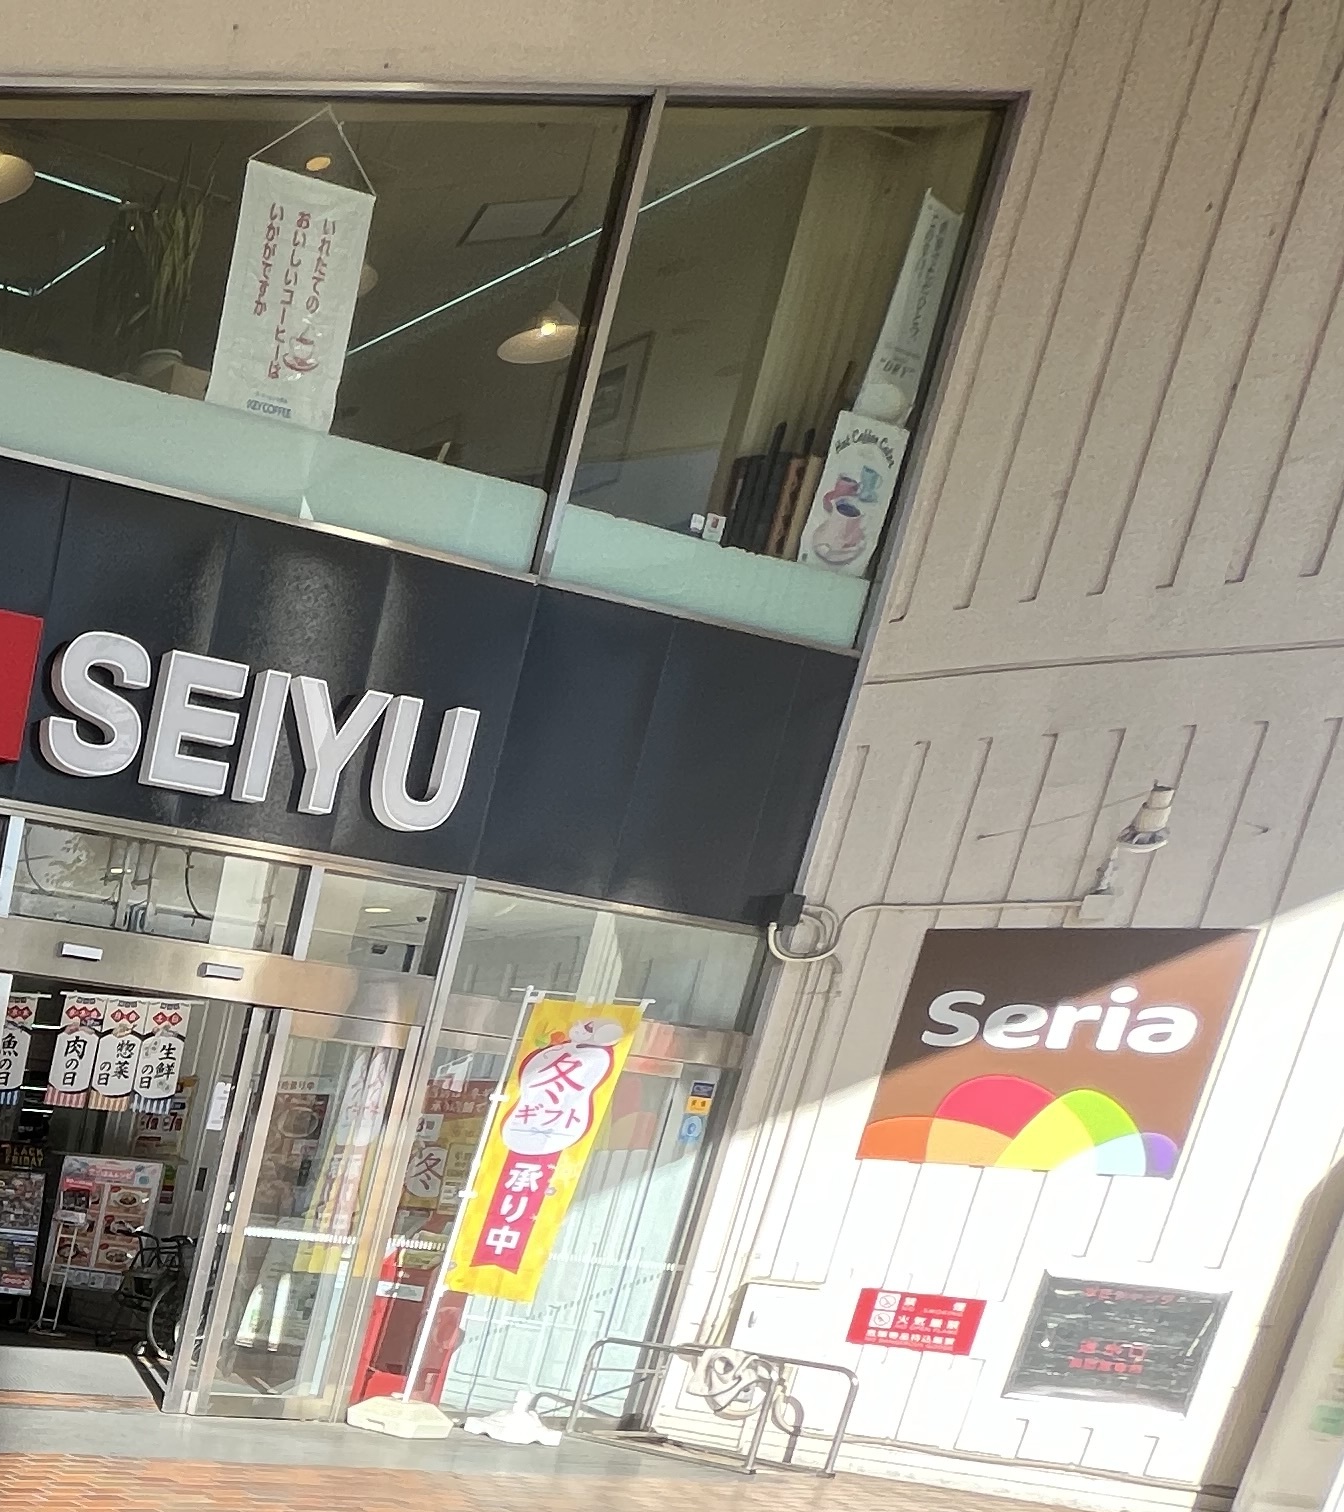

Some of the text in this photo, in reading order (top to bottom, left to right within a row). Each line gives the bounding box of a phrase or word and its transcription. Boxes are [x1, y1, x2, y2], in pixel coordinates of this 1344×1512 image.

[253, 202, 284, 317] いかがですか
[306, 217, 336, 315] いれたての
[268, 211, 311, 380] おいしいコーヒーは
[39, 630, 482, 833] SEIYU
[920, 985, 1199, 1055] Seria
[62, 1035, 88, 1087] 肉の日
[97, 1061, 112, 1086] の日
[112, 1040, 136, 1080] 惣菜
[139, 1064, 154, 1089] の日
[154, 1043, 176, 1081] 生鮮
[528, 1052, 586, 1105] 冬
[514, 1103, 581, 1130] ギフト
[484, 1161, 544, 1256] 承り中
